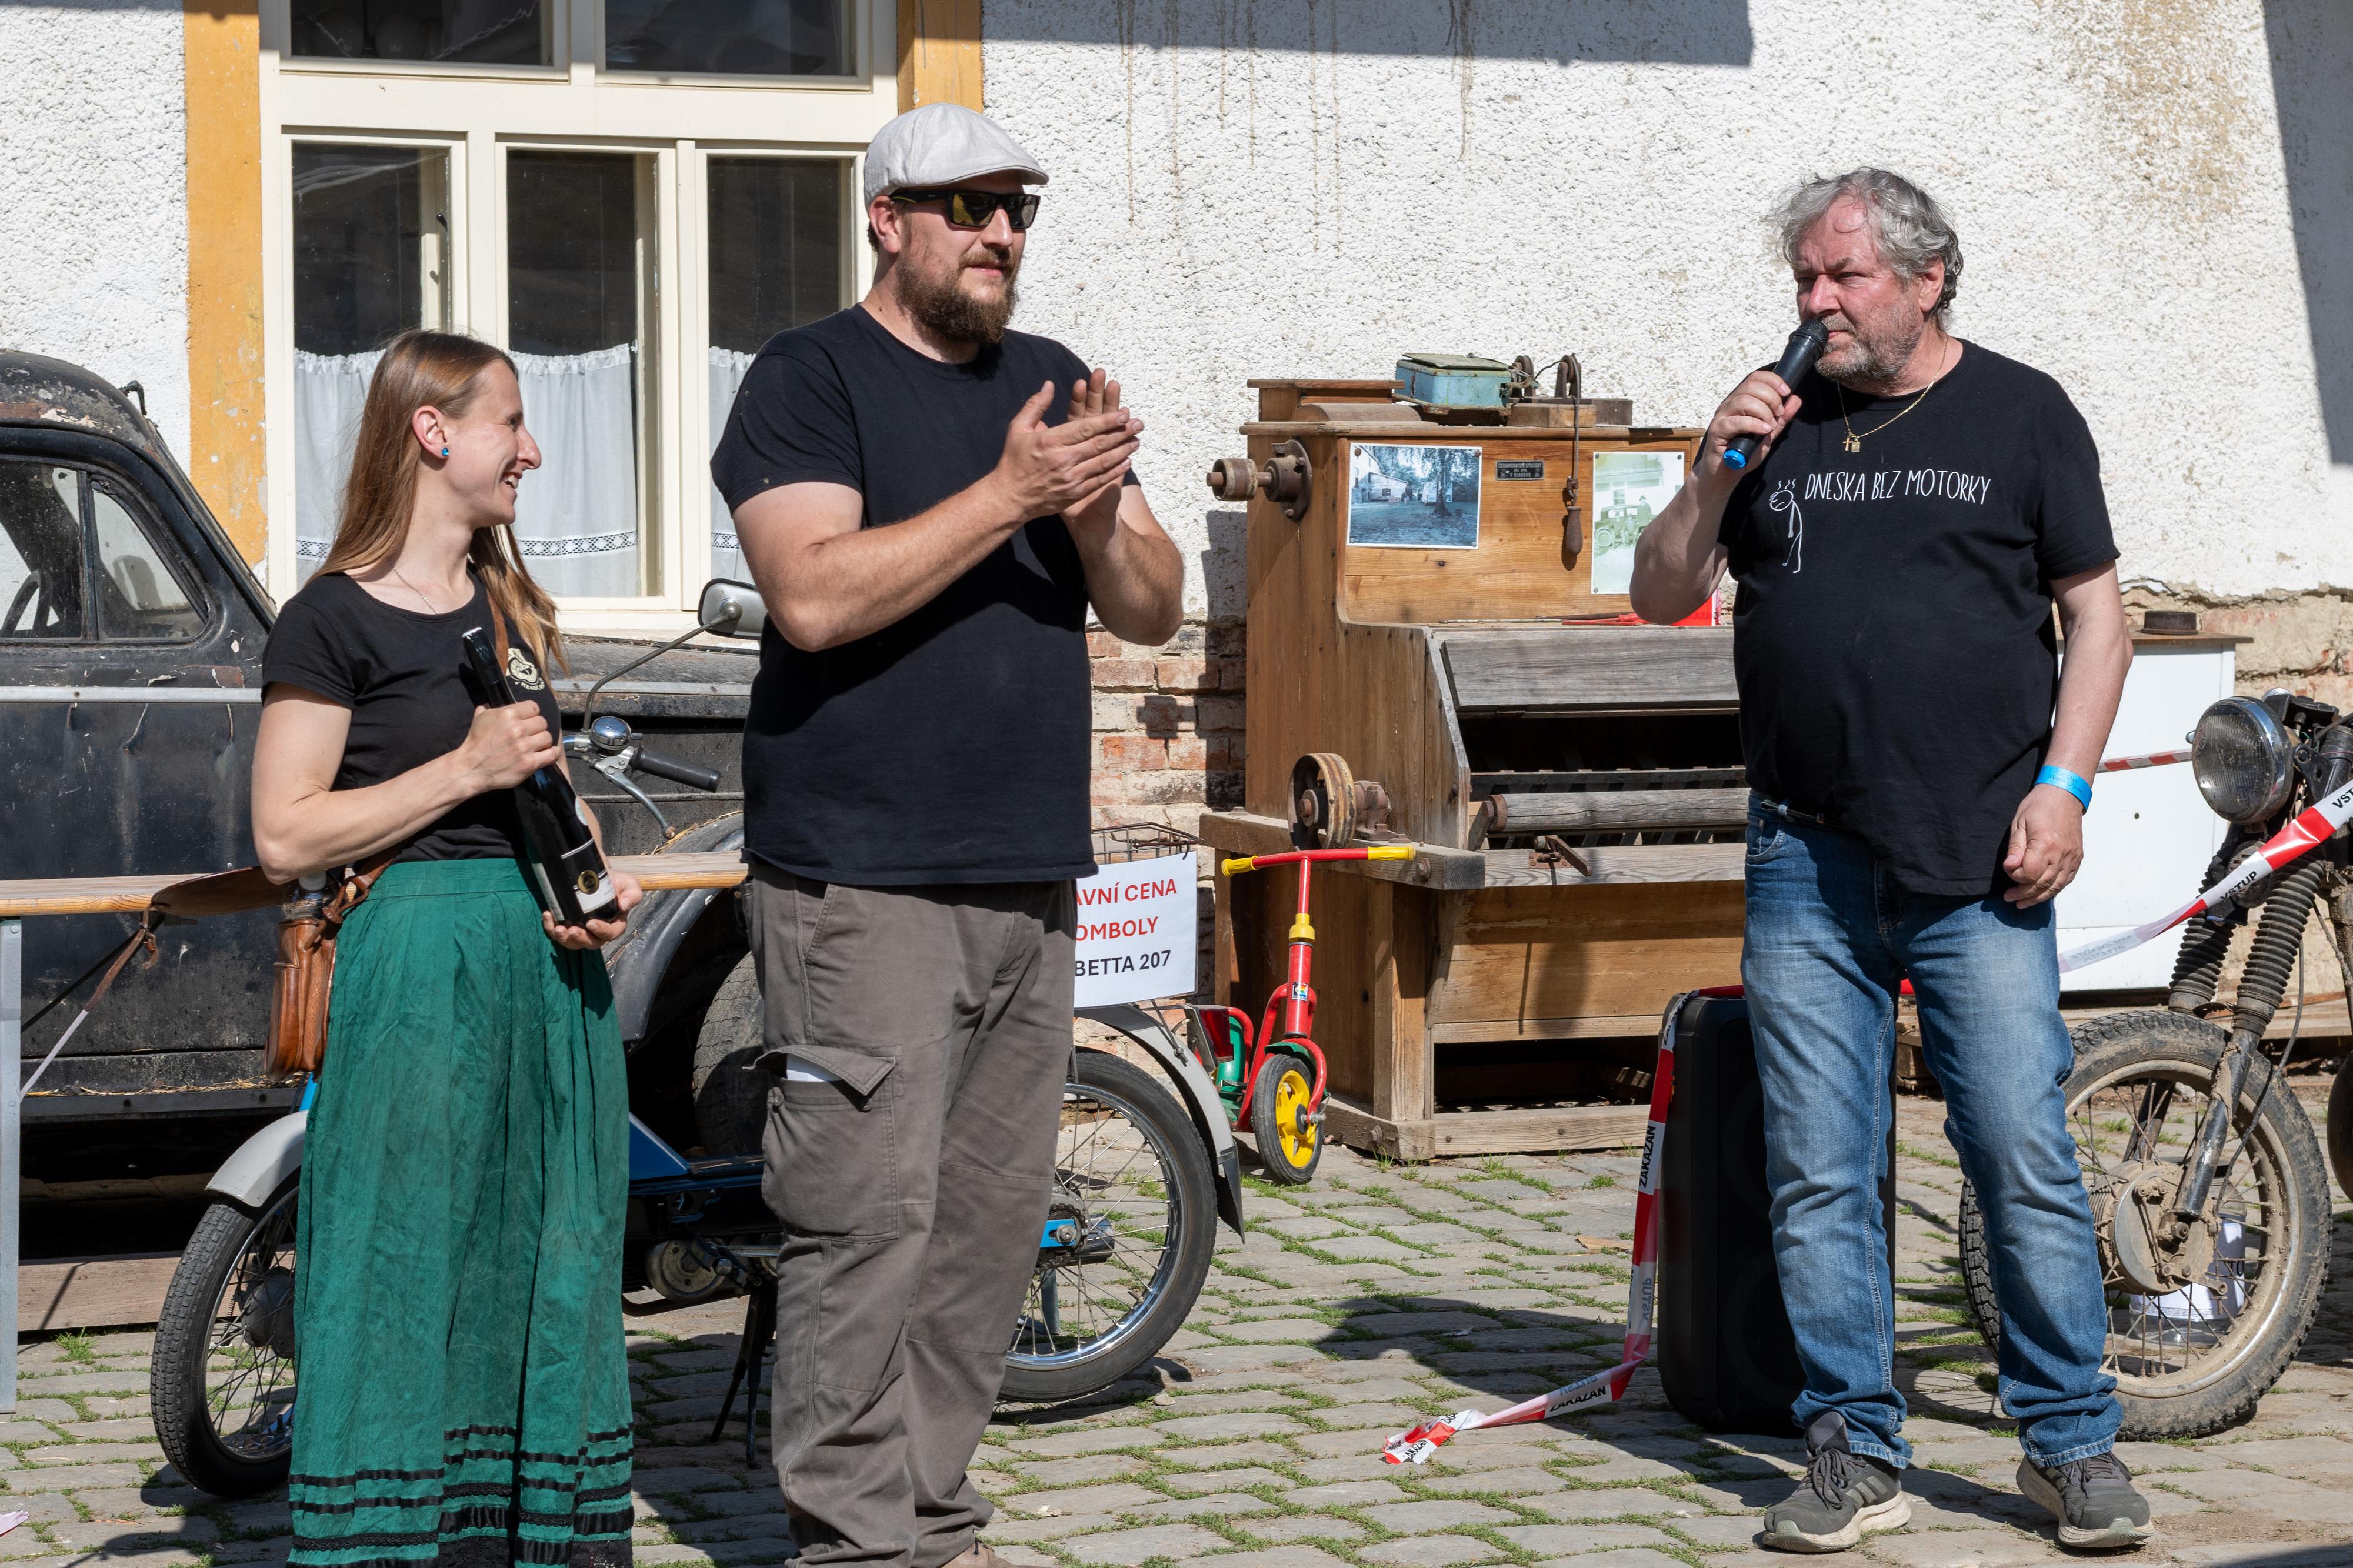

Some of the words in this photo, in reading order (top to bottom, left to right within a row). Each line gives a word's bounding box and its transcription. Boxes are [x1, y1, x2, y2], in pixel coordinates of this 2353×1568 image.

[1805, 472, 1865, 501] DNESKA
[1871, 471, 1901, 500] BEZ
[1905, 469, 1991, 505] MOTORKY
[1125, 879, 1177, 901] CENA
[1076, 916, 1158, 942] OMBOLY
[1075, 956, 1134, 976] BETTA
[1139, 950, 1171, 970] 207
[1639, 1125, 1656, 1188] ZAKAZAN
